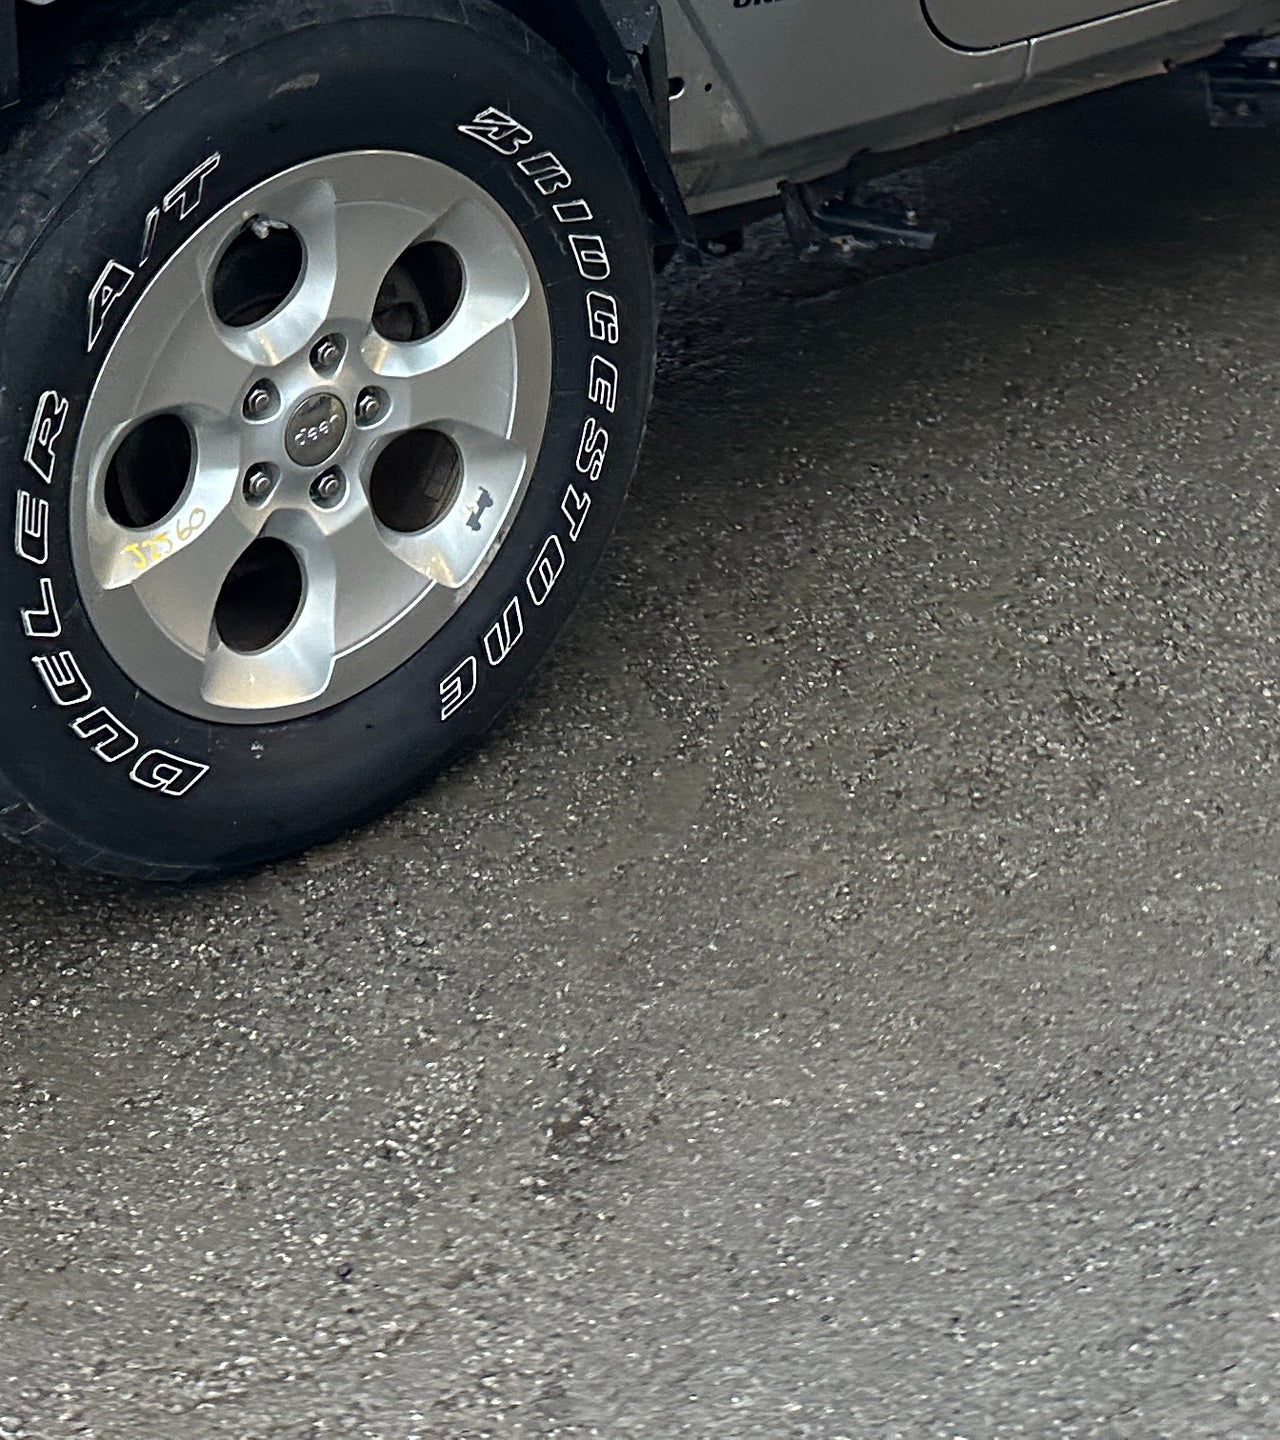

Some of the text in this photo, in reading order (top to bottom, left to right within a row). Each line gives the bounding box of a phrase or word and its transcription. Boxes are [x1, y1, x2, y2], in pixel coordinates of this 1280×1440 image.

[87, 152, 222, 353] A/T
[123, 506, 206, 570] J2560
[439, 106, 619, 721] BRIDGESTONE
[14, 389, 211, 797] DUELER
